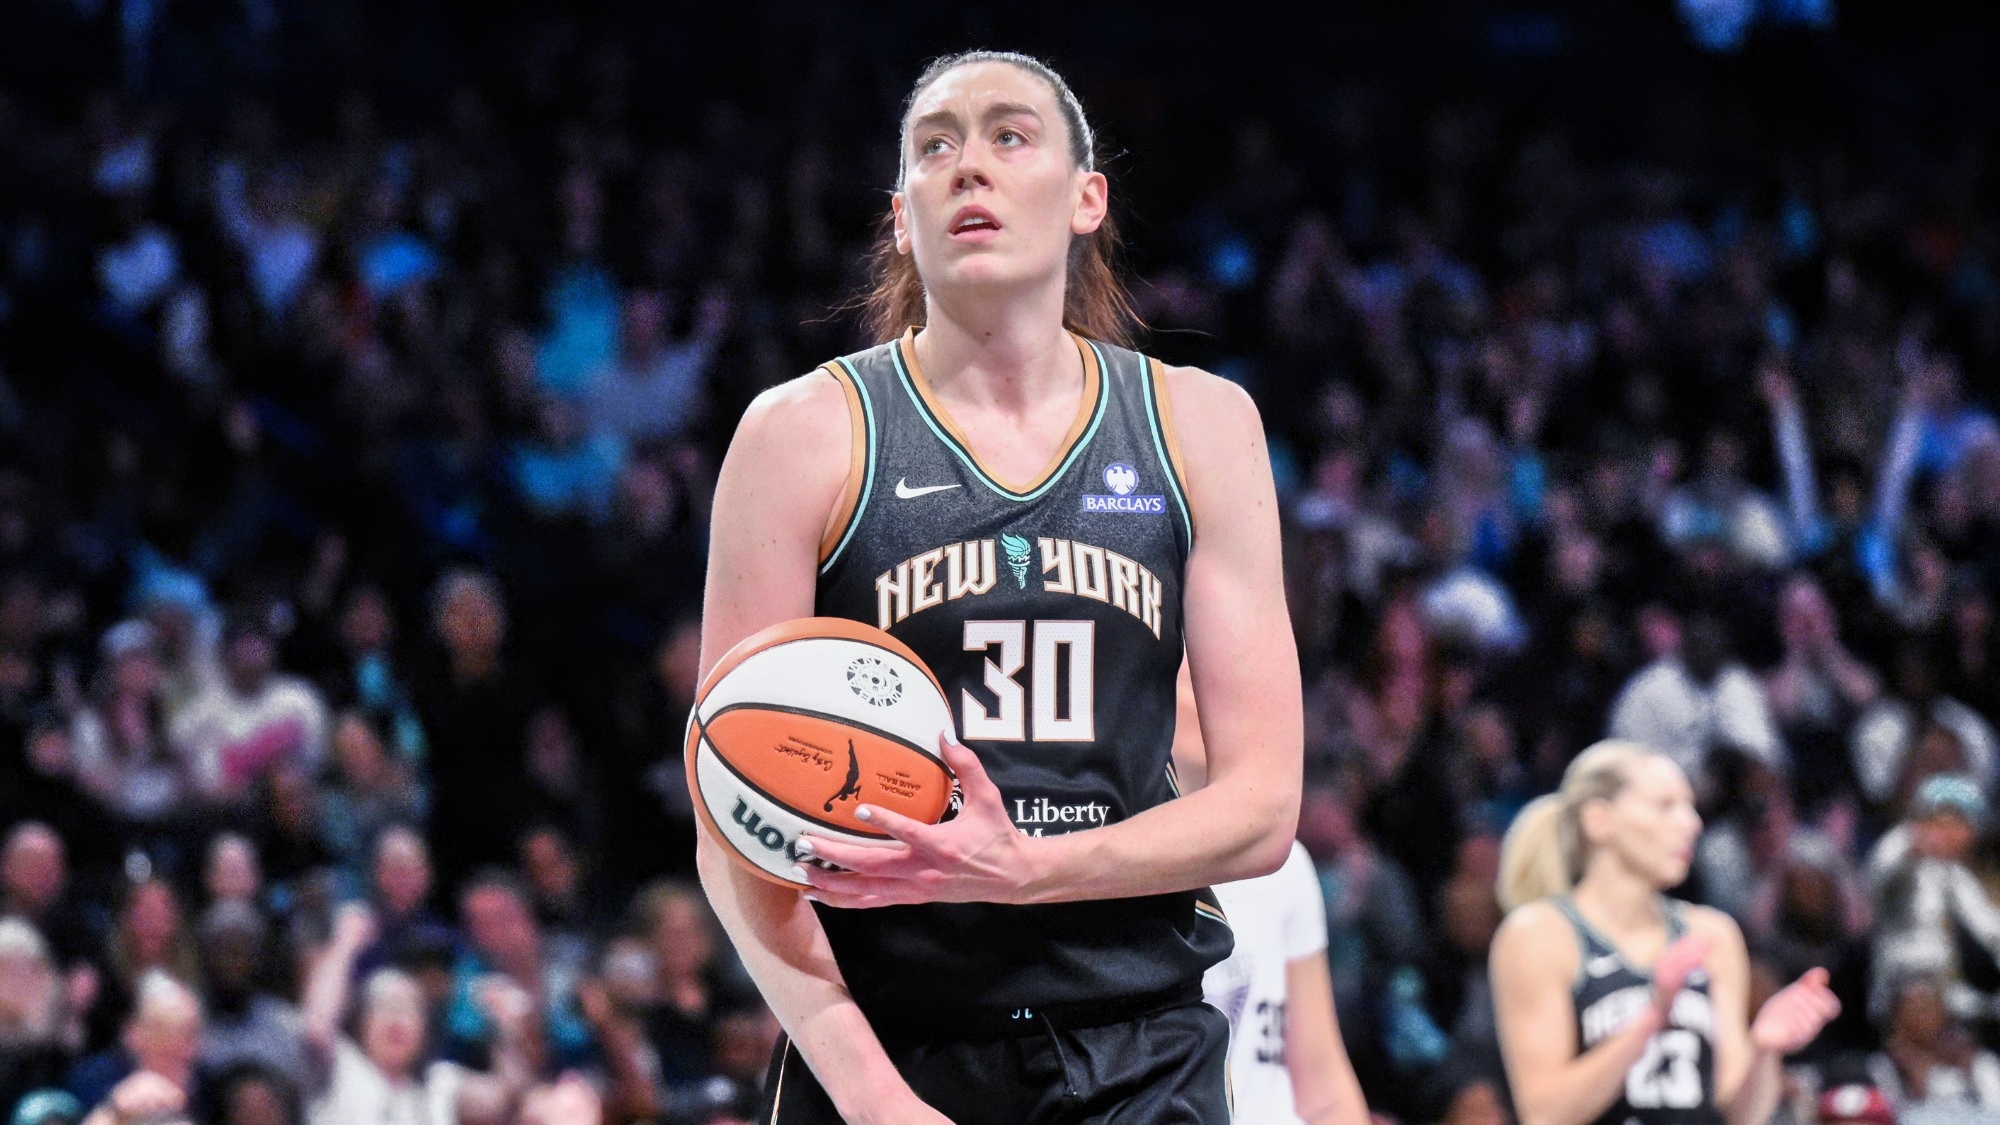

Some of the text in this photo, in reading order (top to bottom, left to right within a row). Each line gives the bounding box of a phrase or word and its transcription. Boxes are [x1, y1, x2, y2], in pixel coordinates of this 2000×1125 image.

[1086, 497, 1162, 512] BARCLAYS
[875, 537, 1162, 640] NEW YORK
[962, 620, 1095, 742] 30
[876, 773, 921, 791] GAME BALL
[880, 783, 914, 798] OFFICIAL
[1015, 798, 1110, 828] Liberty
[1627, 1030, 1703, 1109] 23
